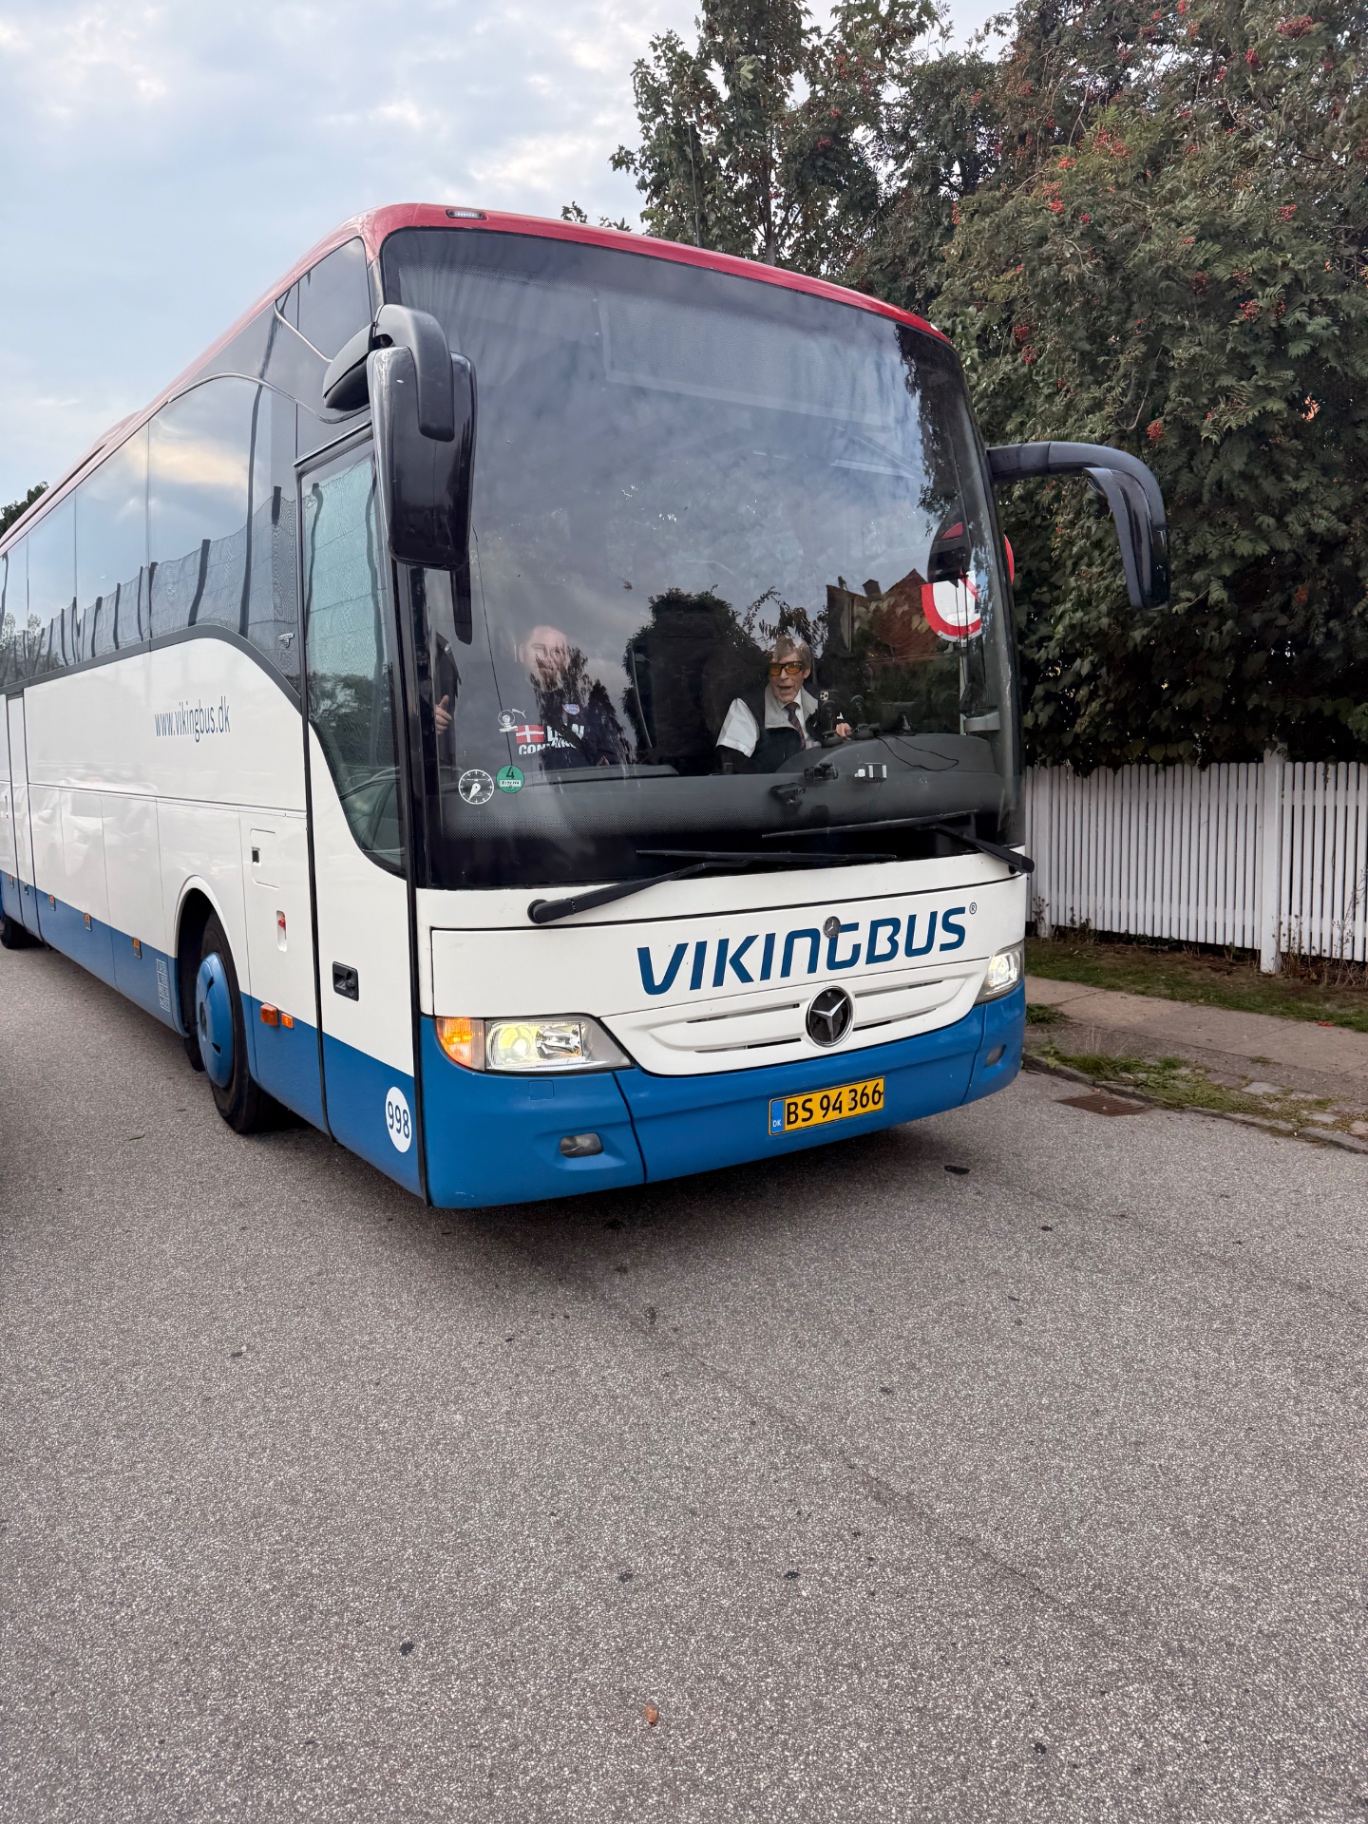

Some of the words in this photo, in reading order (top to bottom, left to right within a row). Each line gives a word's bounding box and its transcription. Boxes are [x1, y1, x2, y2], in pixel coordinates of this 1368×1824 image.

[154, 695, 231, 743] www.vikingbus.dk
[387, 1100, 410, 1139] 998
[772, 1119, 782, 1128] DK
[786, 1098, 814, 1126] BS
[819, 1091, 843, 1119] 94
[847, 1082, 882, 1112] 366
